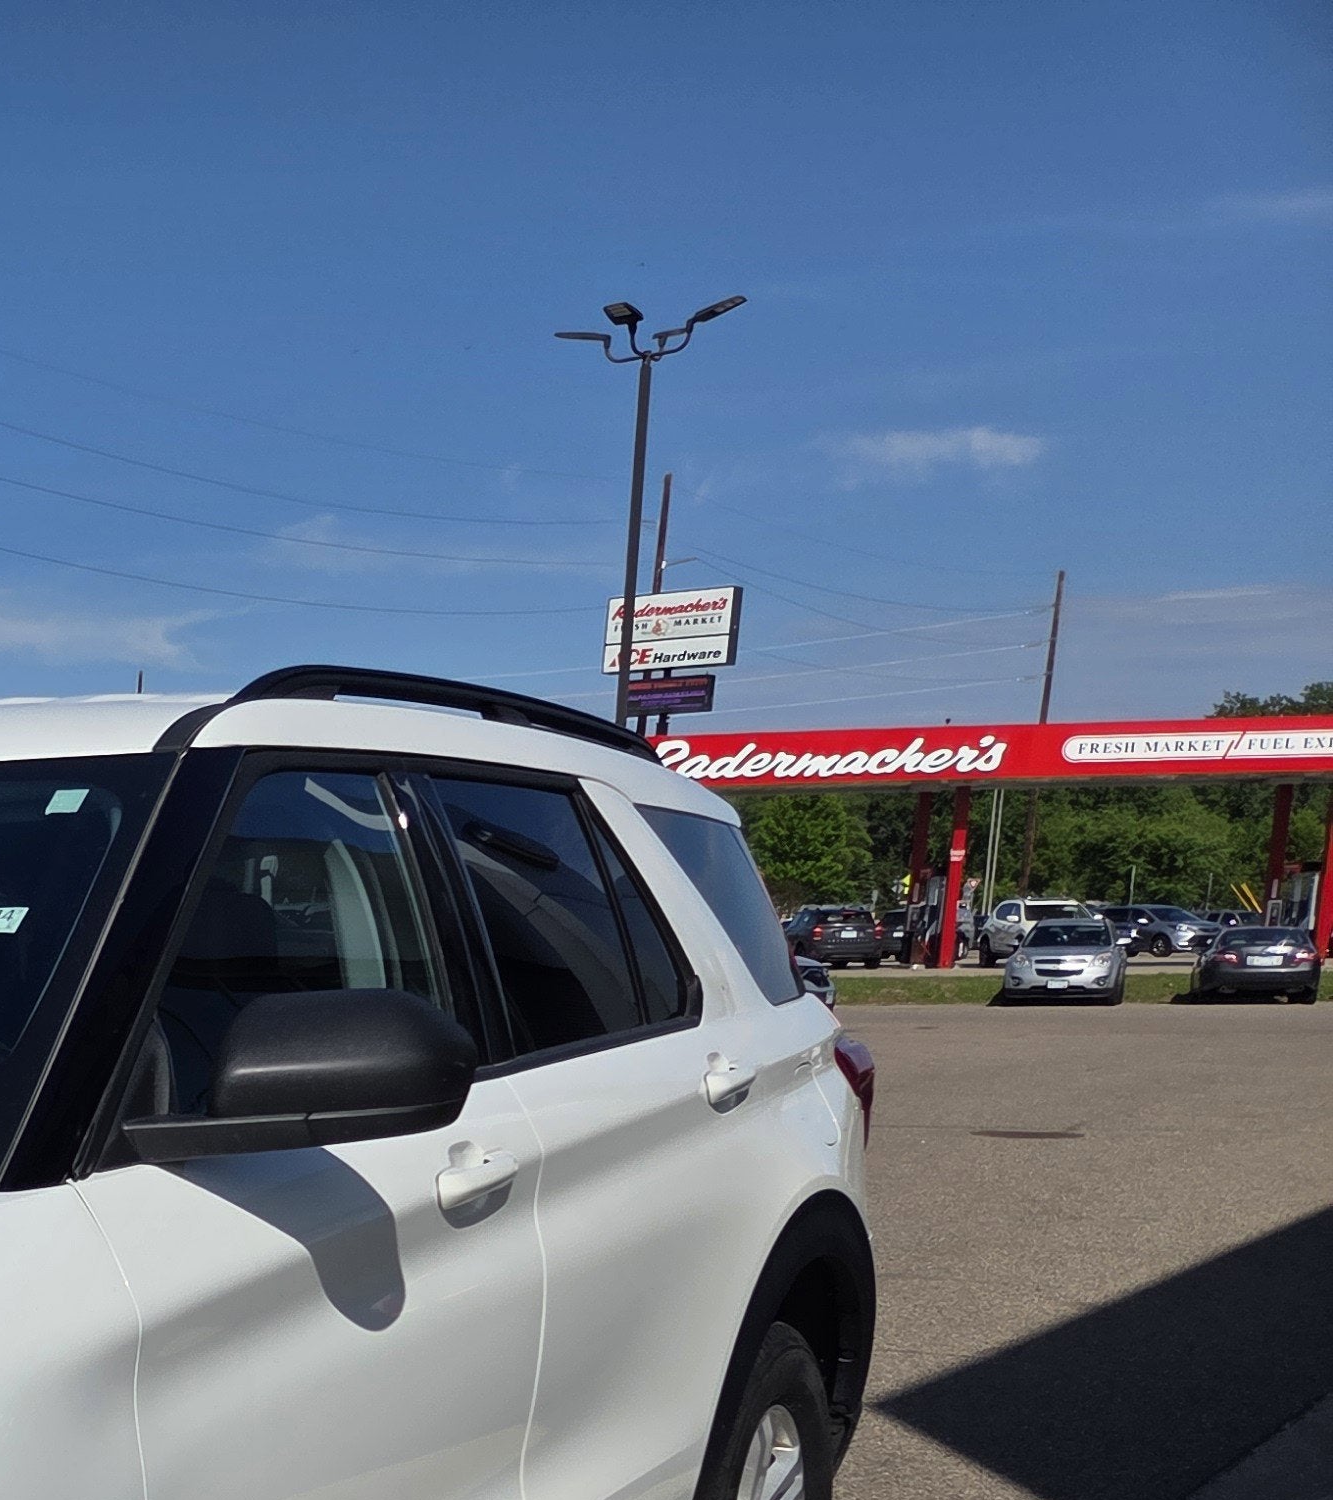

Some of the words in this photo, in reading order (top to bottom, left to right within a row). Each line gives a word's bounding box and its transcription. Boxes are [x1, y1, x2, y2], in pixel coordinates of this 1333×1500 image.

[612, 597, 729, 622] Rdermacher's
[614, 622, 648, 632] FSH
[673, 616, 723, 627] MARKET
[652, 649, 722, 664] Hardware
[1078, 740, 1136, 755] FRESH
[1143, 739, 1225, 754] MARKET
[1247, 737, 1295, 750] FUEL
[655, 735, 1008, 780] Radermacher's
